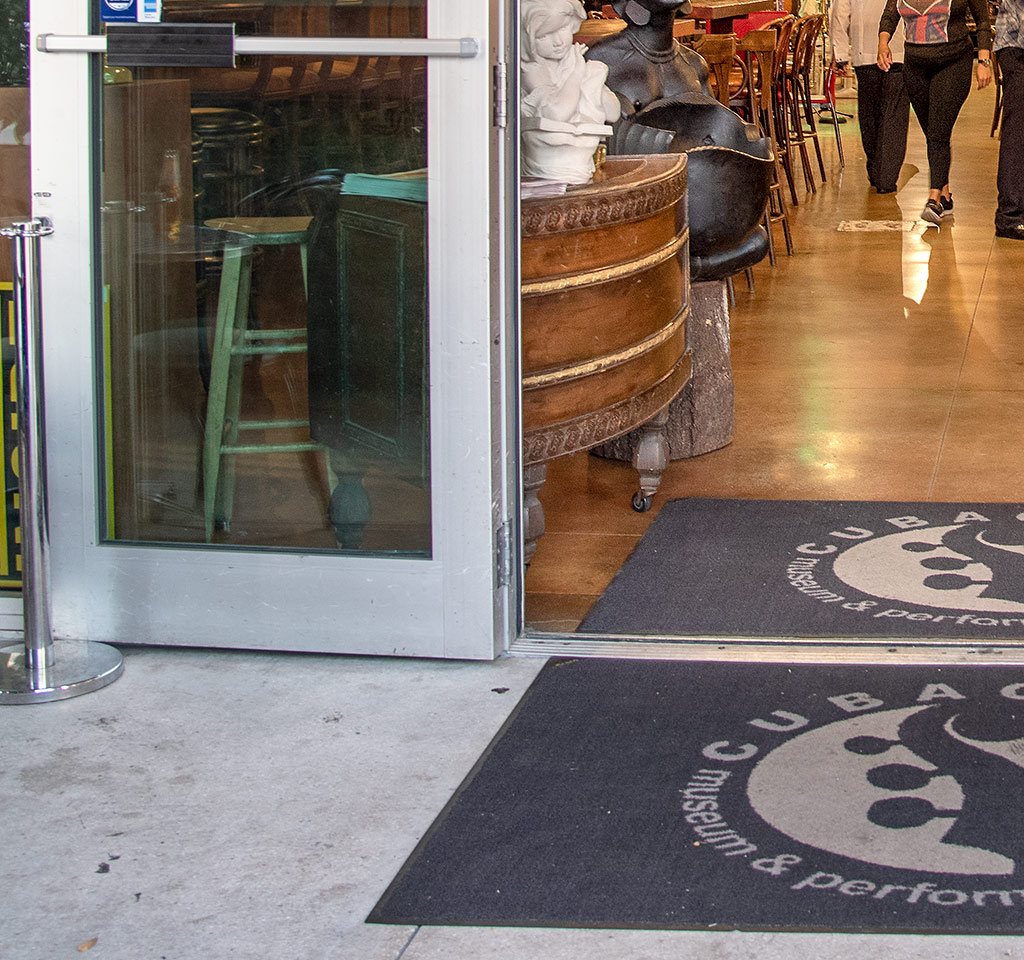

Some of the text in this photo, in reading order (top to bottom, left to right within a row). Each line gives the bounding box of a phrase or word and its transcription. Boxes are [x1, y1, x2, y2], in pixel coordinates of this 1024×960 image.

[786, 557, 845, 603] museum
[841, 599, 878, 612] &
[678, 767, 759, 858] museum
[750, 852, 801, 876] &
